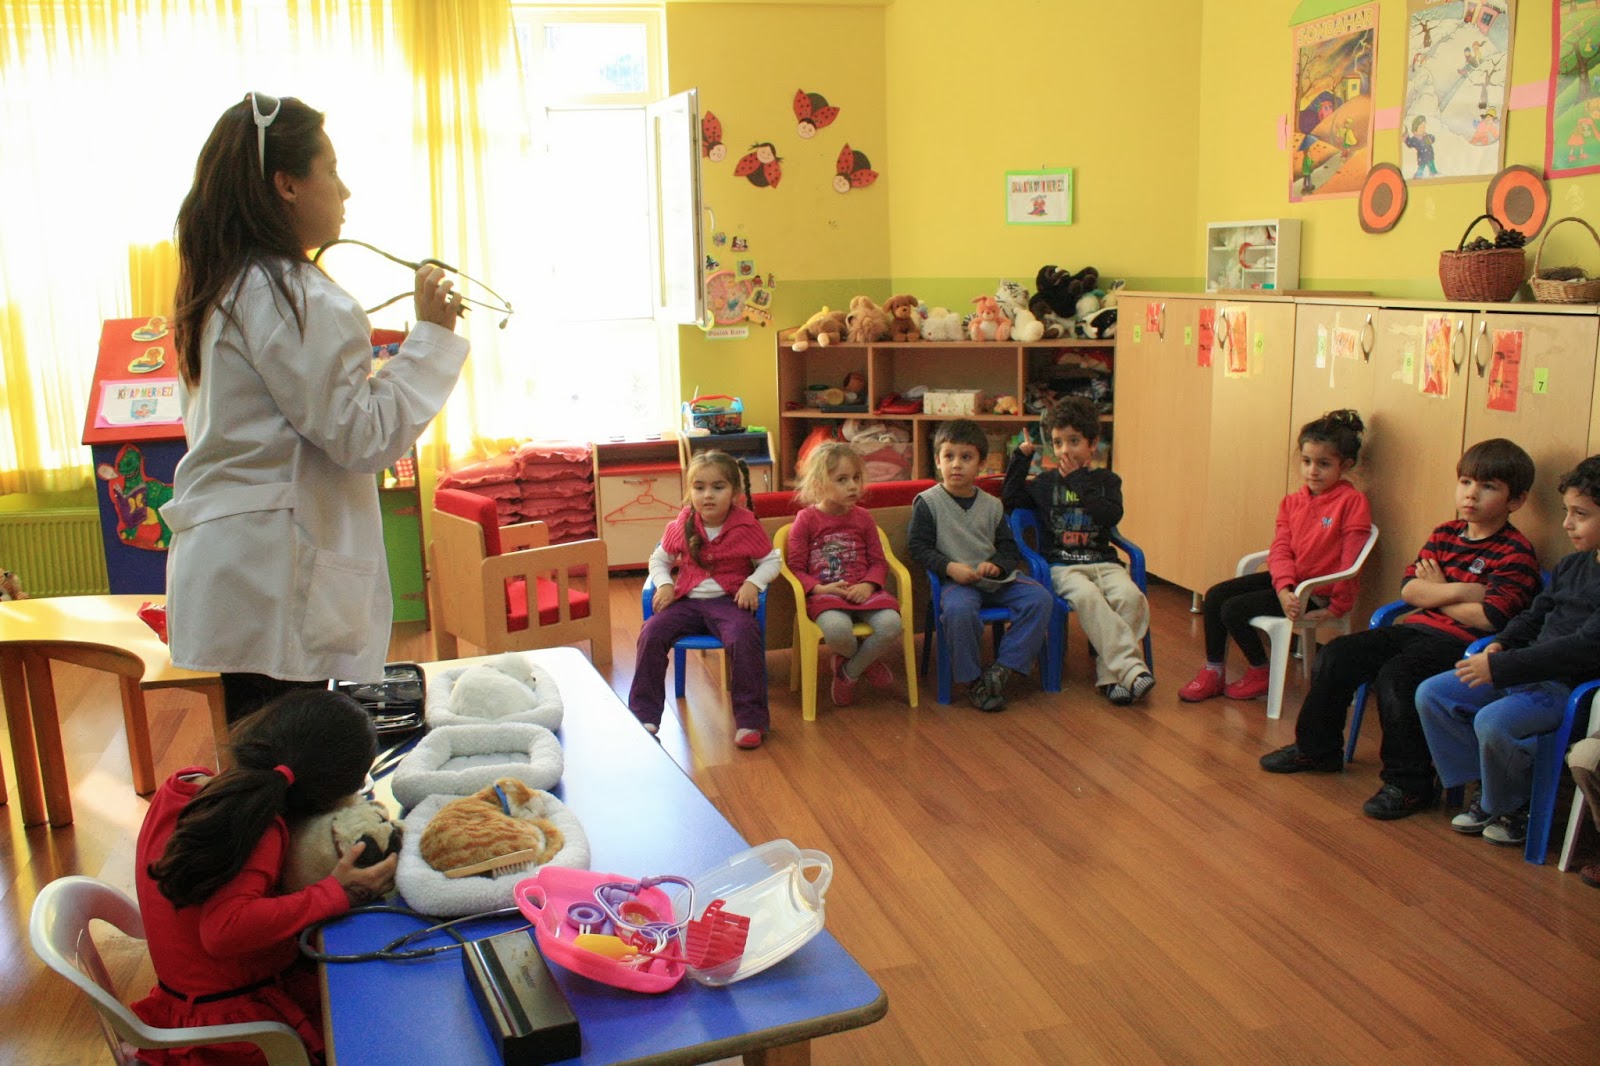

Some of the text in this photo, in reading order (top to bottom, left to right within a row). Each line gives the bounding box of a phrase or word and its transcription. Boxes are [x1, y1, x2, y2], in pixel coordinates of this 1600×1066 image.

[1297, 8, 1374, 45] SONBAHAR
[1538, 381, 1544, 391] 7
[1062, 531, 1090, 544] CITY
